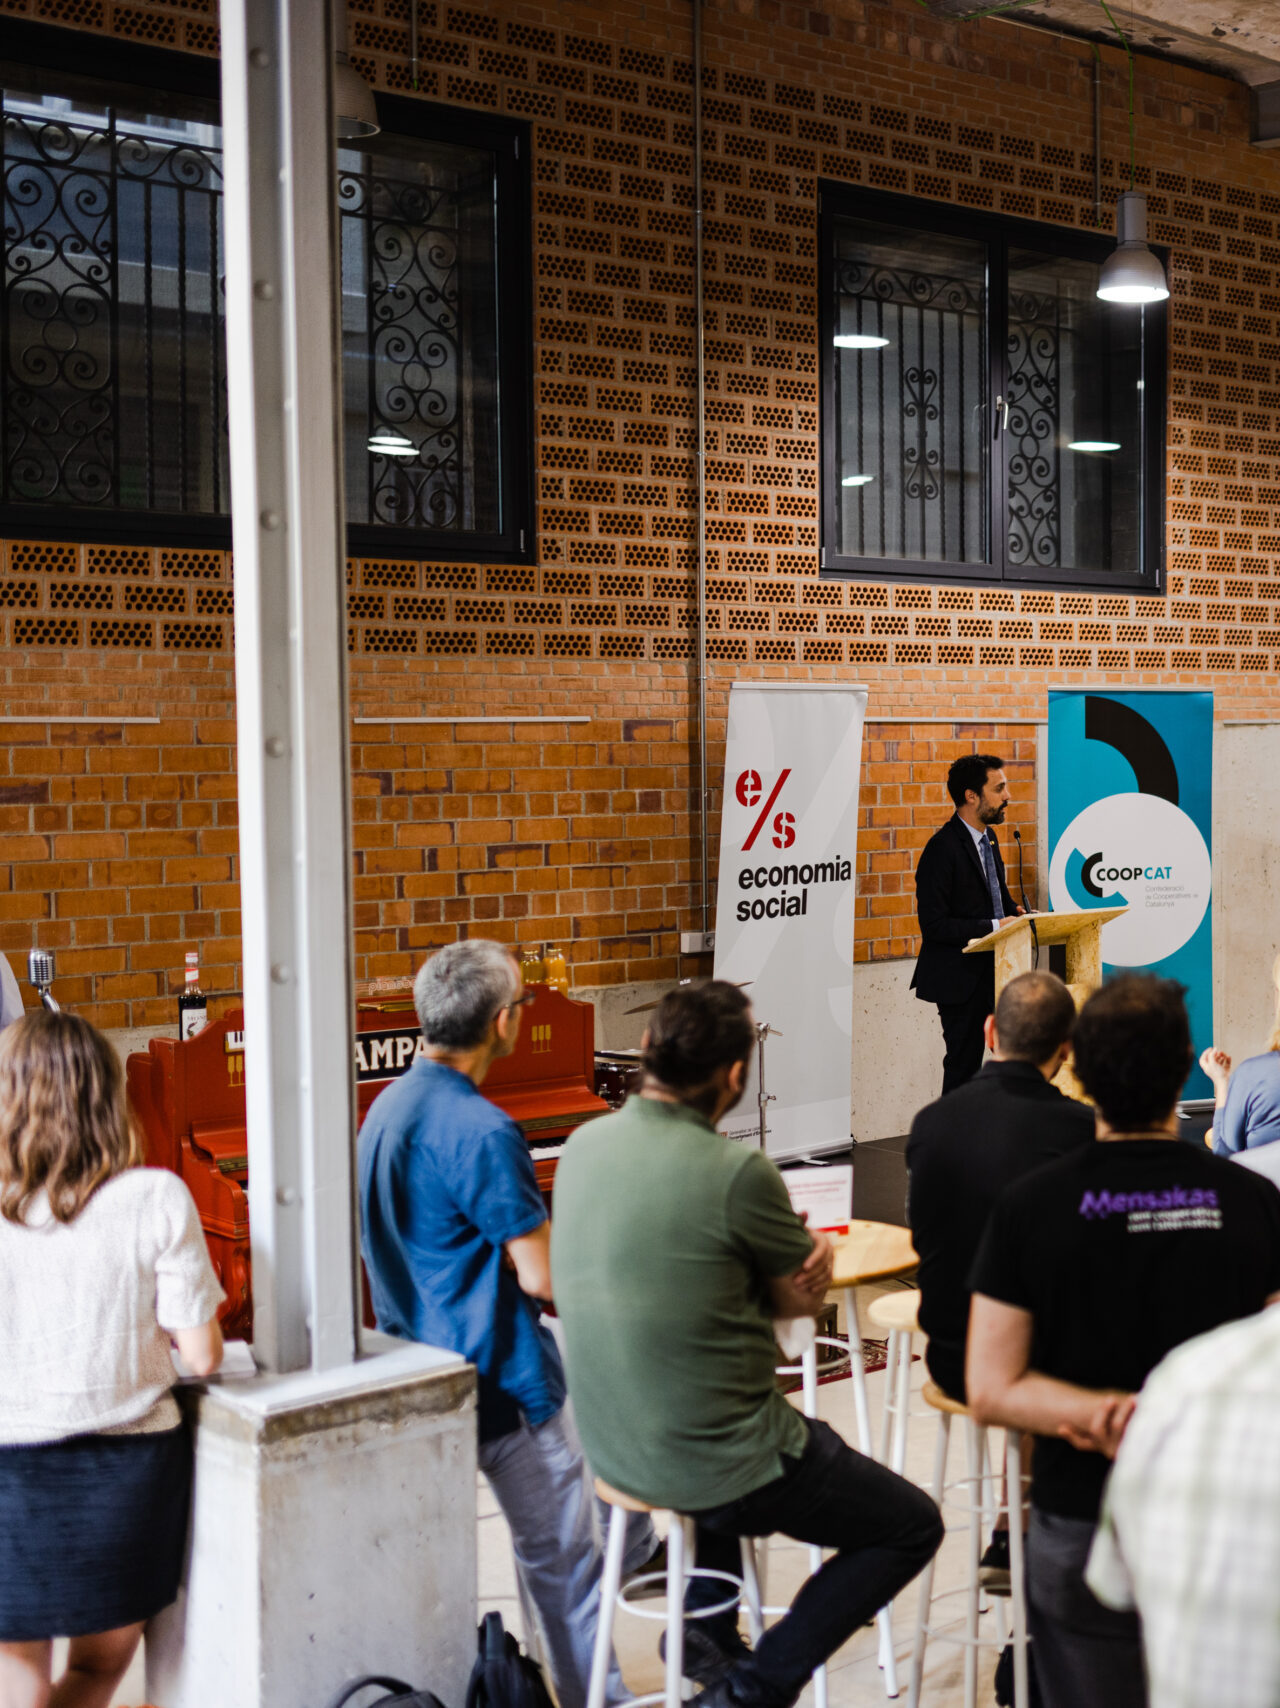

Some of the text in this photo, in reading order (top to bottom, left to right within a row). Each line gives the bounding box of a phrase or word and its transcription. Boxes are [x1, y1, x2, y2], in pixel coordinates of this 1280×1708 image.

[738, 855, 852, 890] economia
[1096, 866, 1173, 882] COOPCAT
[736, 888, 808, 922] social
[1079, 1185, 1218, 1219] Mensakas
